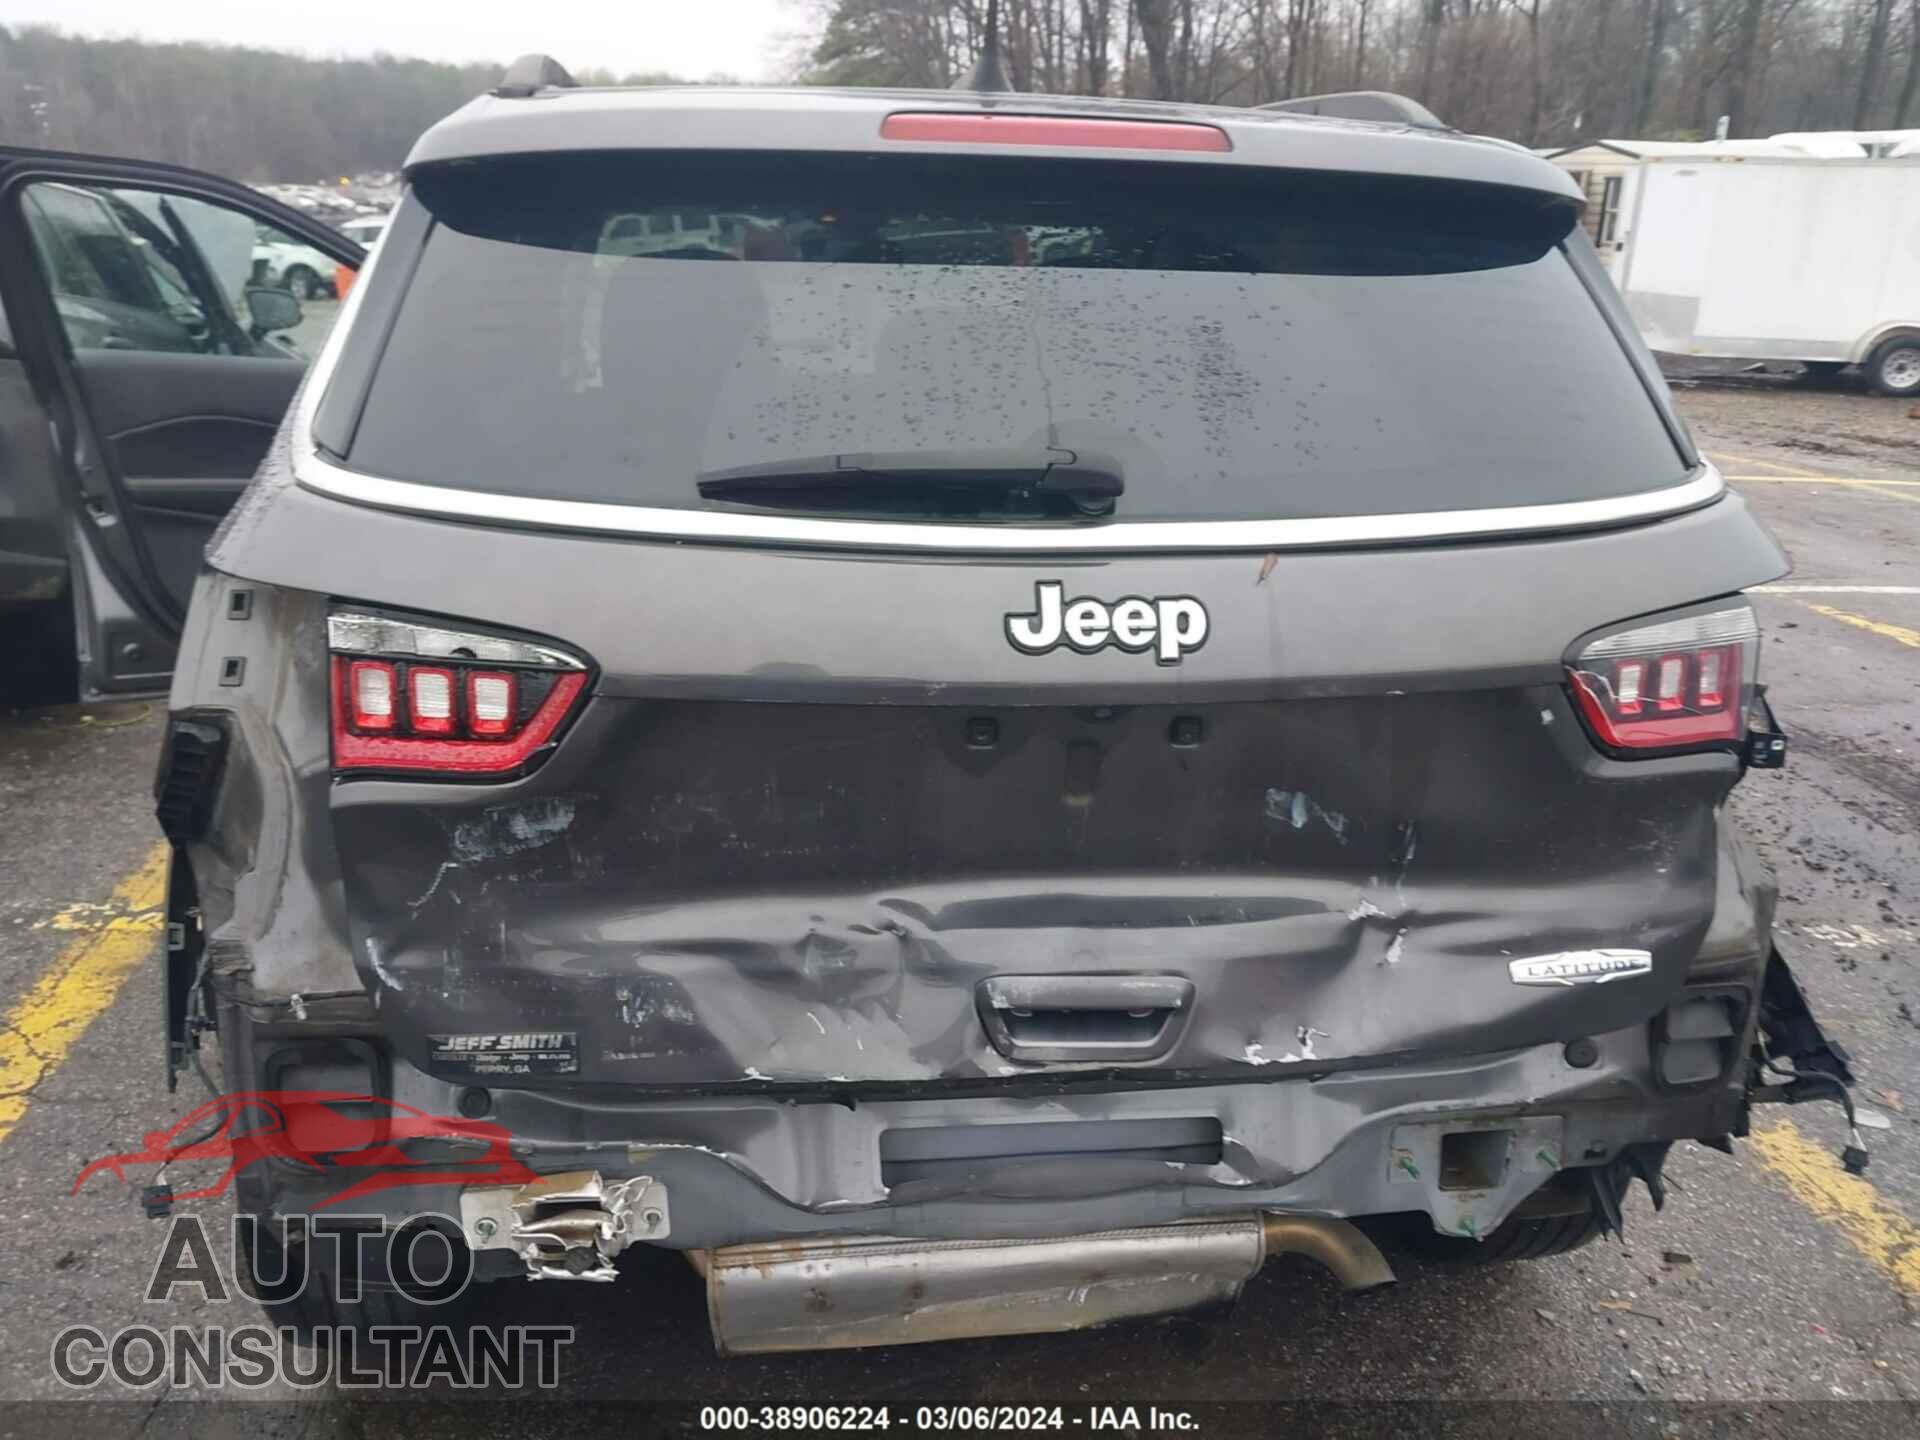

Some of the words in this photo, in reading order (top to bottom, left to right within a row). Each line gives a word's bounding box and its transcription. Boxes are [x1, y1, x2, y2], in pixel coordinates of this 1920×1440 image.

[1005, 581, 1209, 665] Jeep
[1526, 957, 1643, 977] LATITUDE
[438, 1036, 497, 1051] JEFF
[496, 1033, 563, 1050] SMITH
